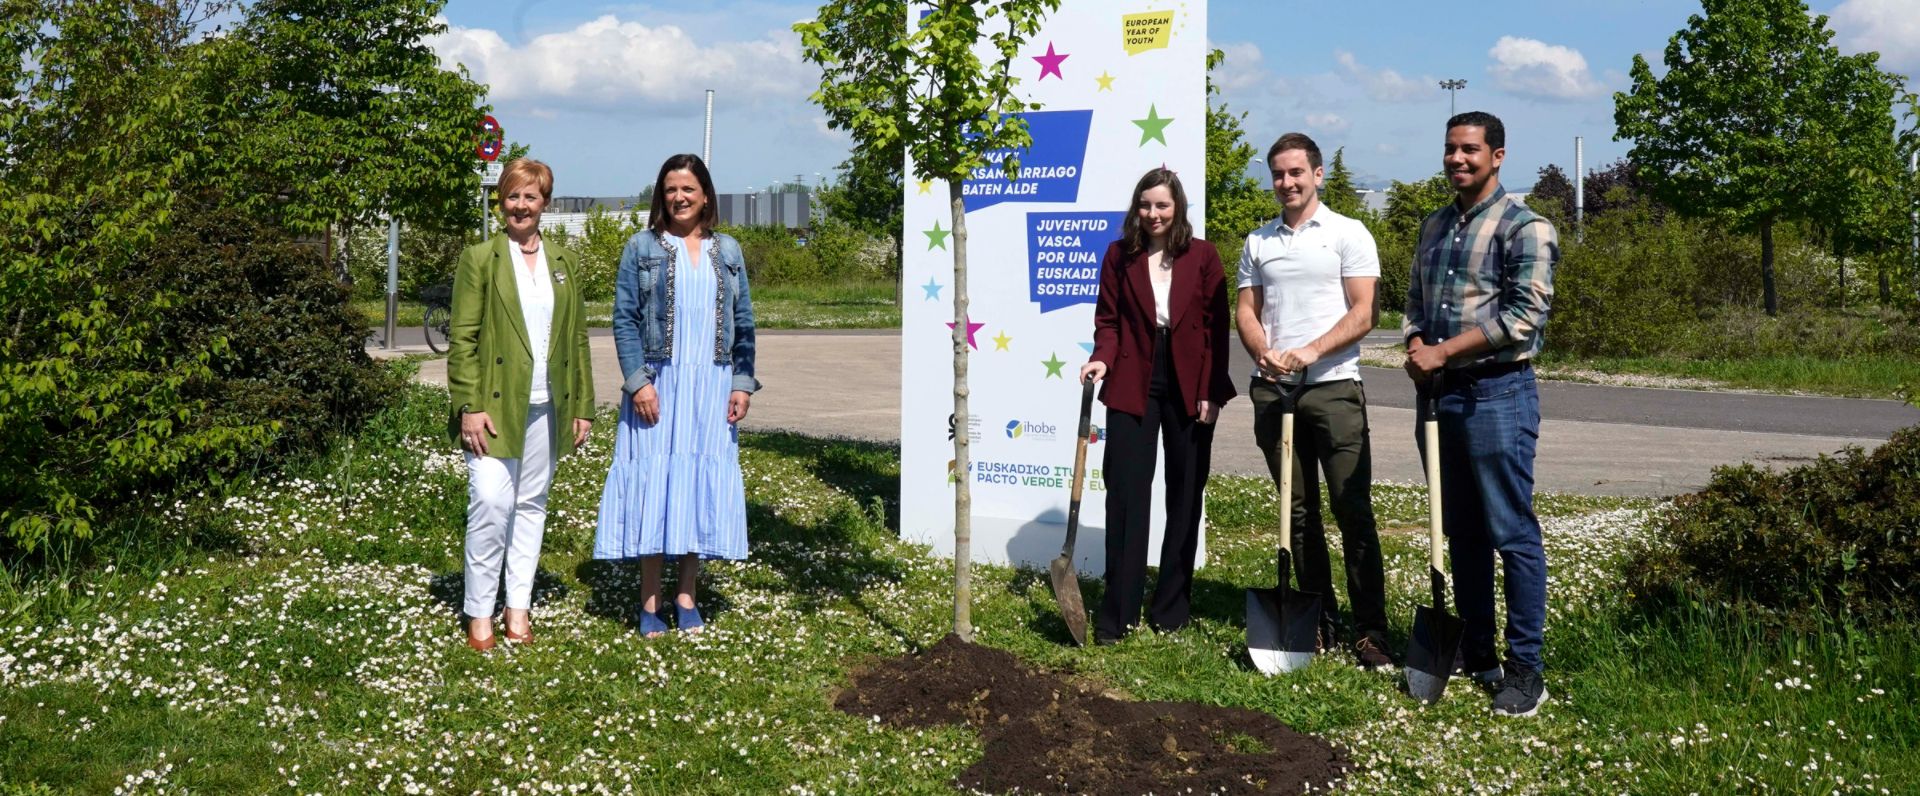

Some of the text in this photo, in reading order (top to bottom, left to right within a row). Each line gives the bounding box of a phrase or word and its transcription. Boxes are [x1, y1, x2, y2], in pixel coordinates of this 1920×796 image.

[1125, 18, 1169, 26] EUROPEAN
[1126, 27, 1160, 36] YEAR OF
[1126, 37, 1154, 45] YOUTH
[962, 182, 1039, 195] BATEN ALDE
[1036, 219, 1108, 231] JUVENTUD
[1037, 235, 1082, 247] VASCA
[1037, 251, 1097, 263] POR UNA
[1037, 267, 1098, 279] EUSKADI
[1024, 421, 1056, 434] ihobe
[977, 461, 1049, 475] EUSKADIKO
[977, 472, 1017, 485] PACTO
[1021, 476, 1063, 488] VERDE
